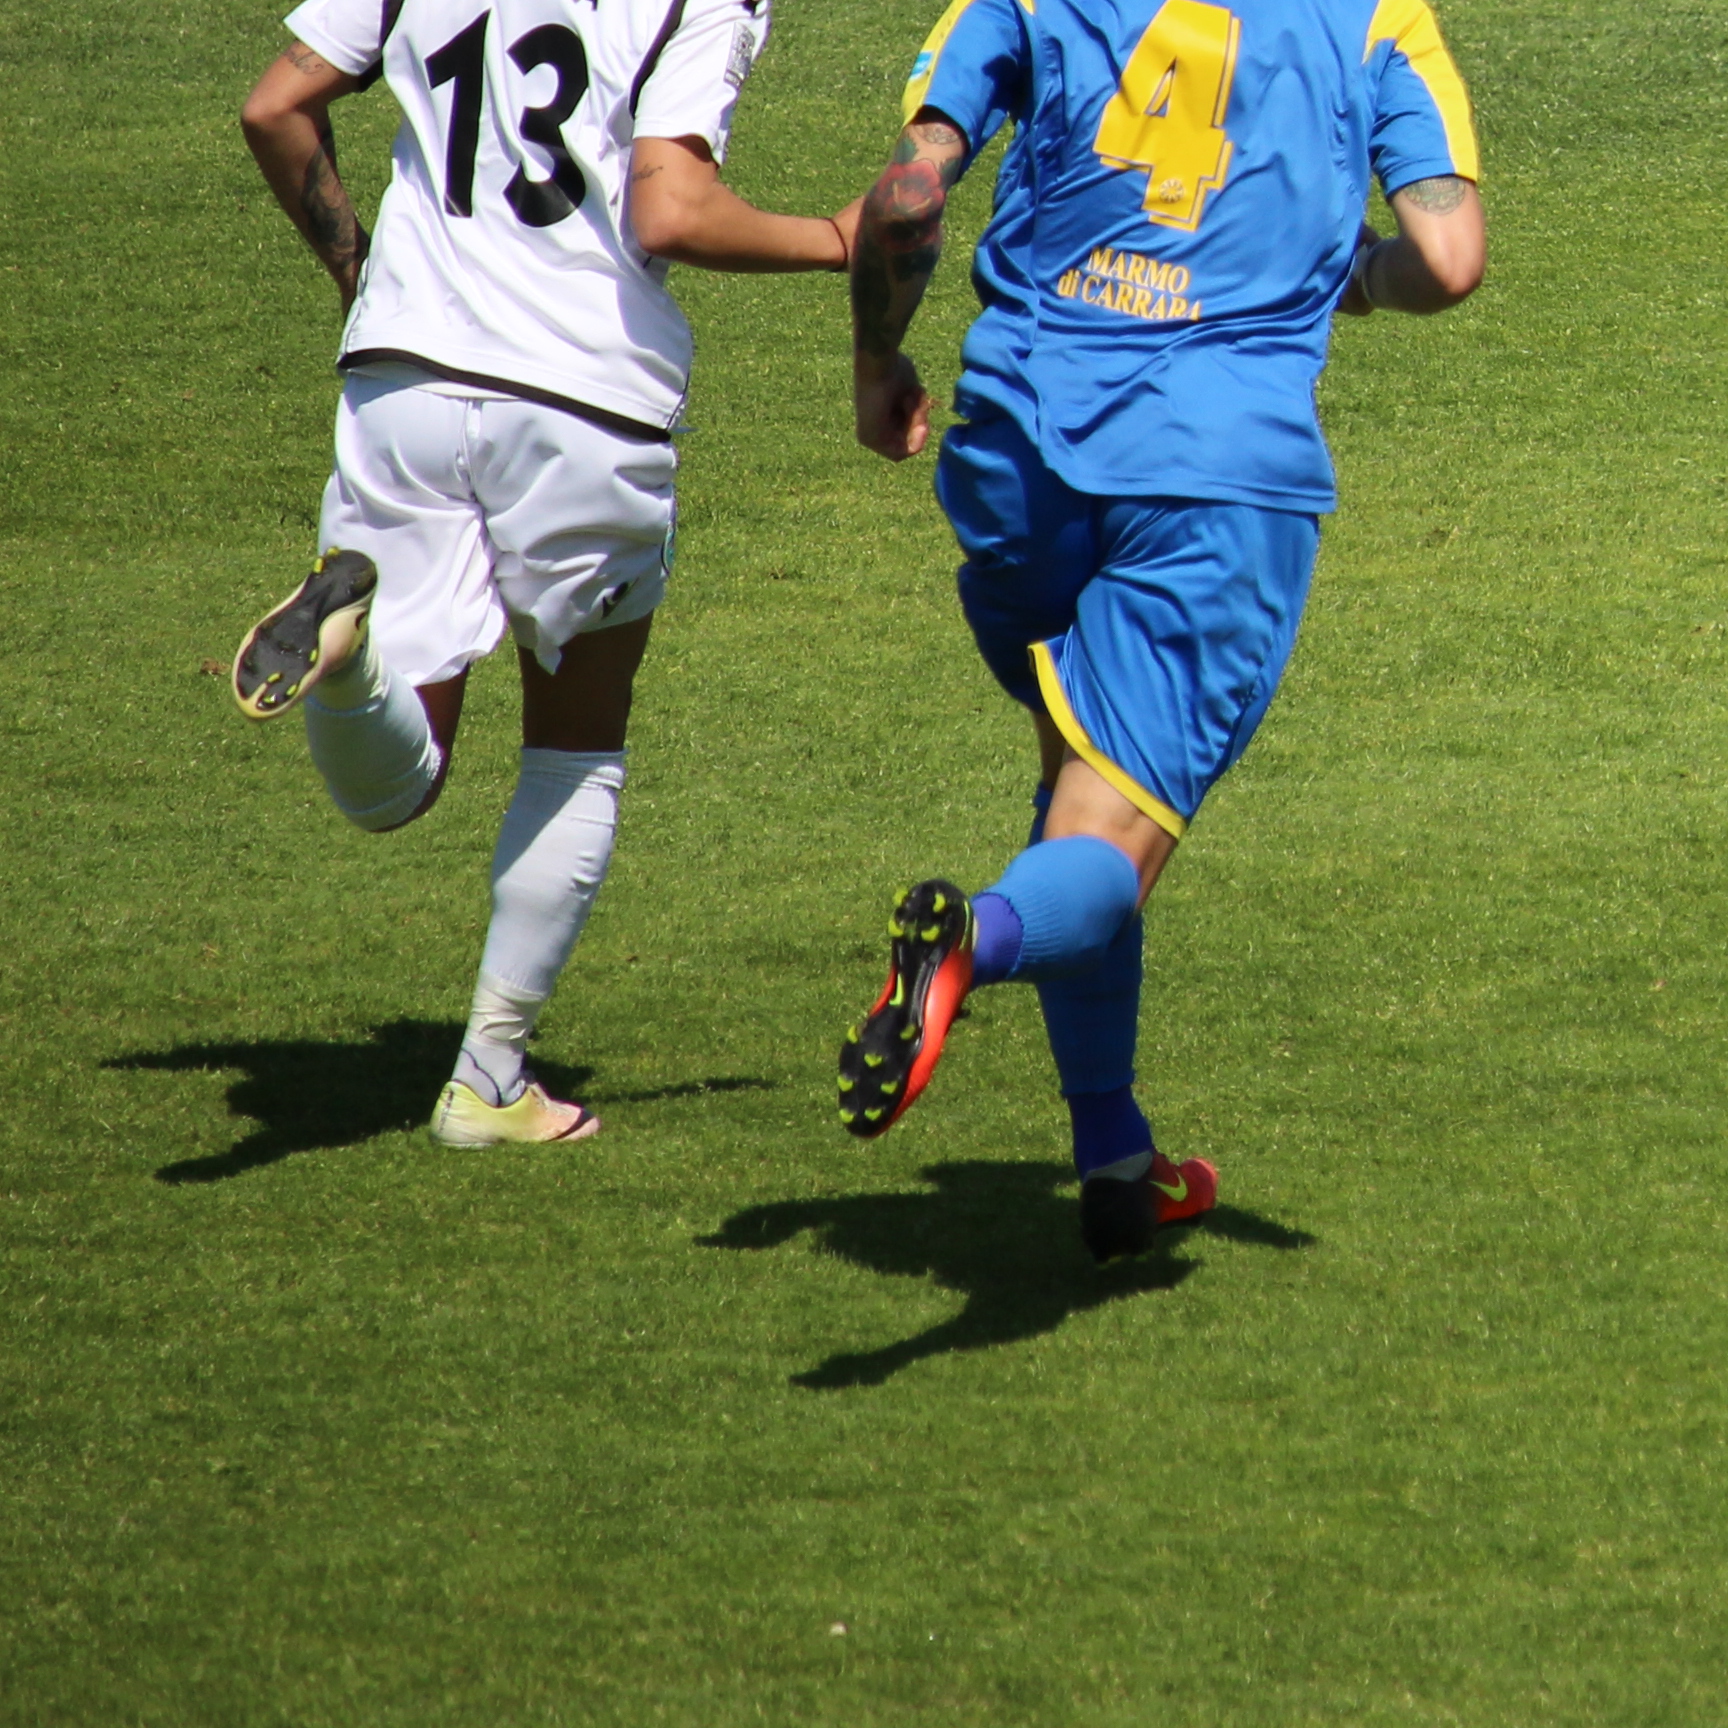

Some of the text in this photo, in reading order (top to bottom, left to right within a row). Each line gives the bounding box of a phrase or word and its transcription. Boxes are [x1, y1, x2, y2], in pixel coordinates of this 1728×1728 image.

[424, 7, 589, 229] 13
[1056, 268, 1203, 322] di CARRARA
[1085, 246, 1191, 295] MARMO
